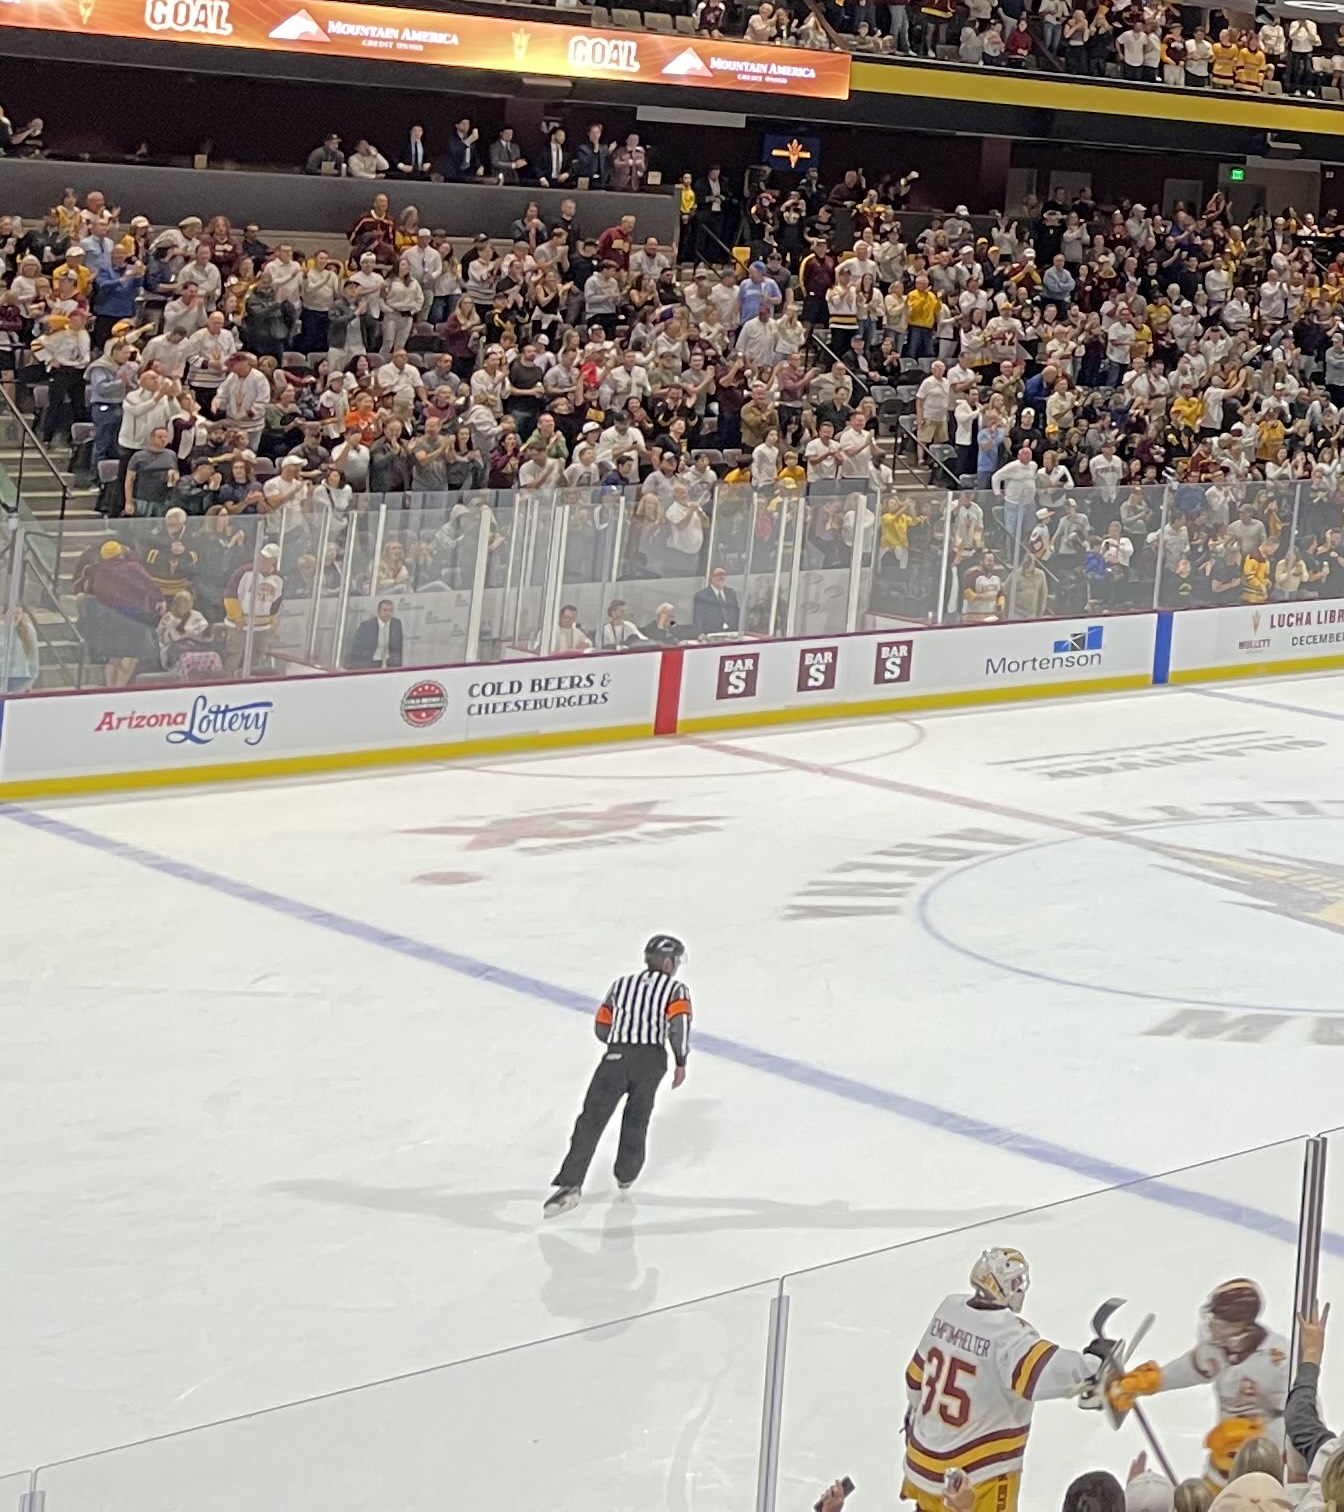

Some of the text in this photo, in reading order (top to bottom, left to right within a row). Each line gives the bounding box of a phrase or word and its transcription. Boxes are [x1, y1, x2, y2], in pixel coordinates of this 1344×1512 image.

[401, 28, 459, 45] AMERICA
[568, 35, 640, 73] GOAL
[1270, 612, 1312, 628] LUCHA
[804, 651, 833, 665] BAR
[881, 644, 907, 659] BAR
[724, 658, 754, 673] BAR
[884, 657, 901, 679] S
[985, 653, 1102, 675] Mortenson
[468, 673, 612, 698] COLD BEERS &
[727, 671, 746, 694] S
[808, 664, 826, 687] S
[467, 692, 610, 716] CHEESEBURGERS
[94, 694, 273, 745] Arizona Lottery
[922, 1347, 976, 1427] 35
